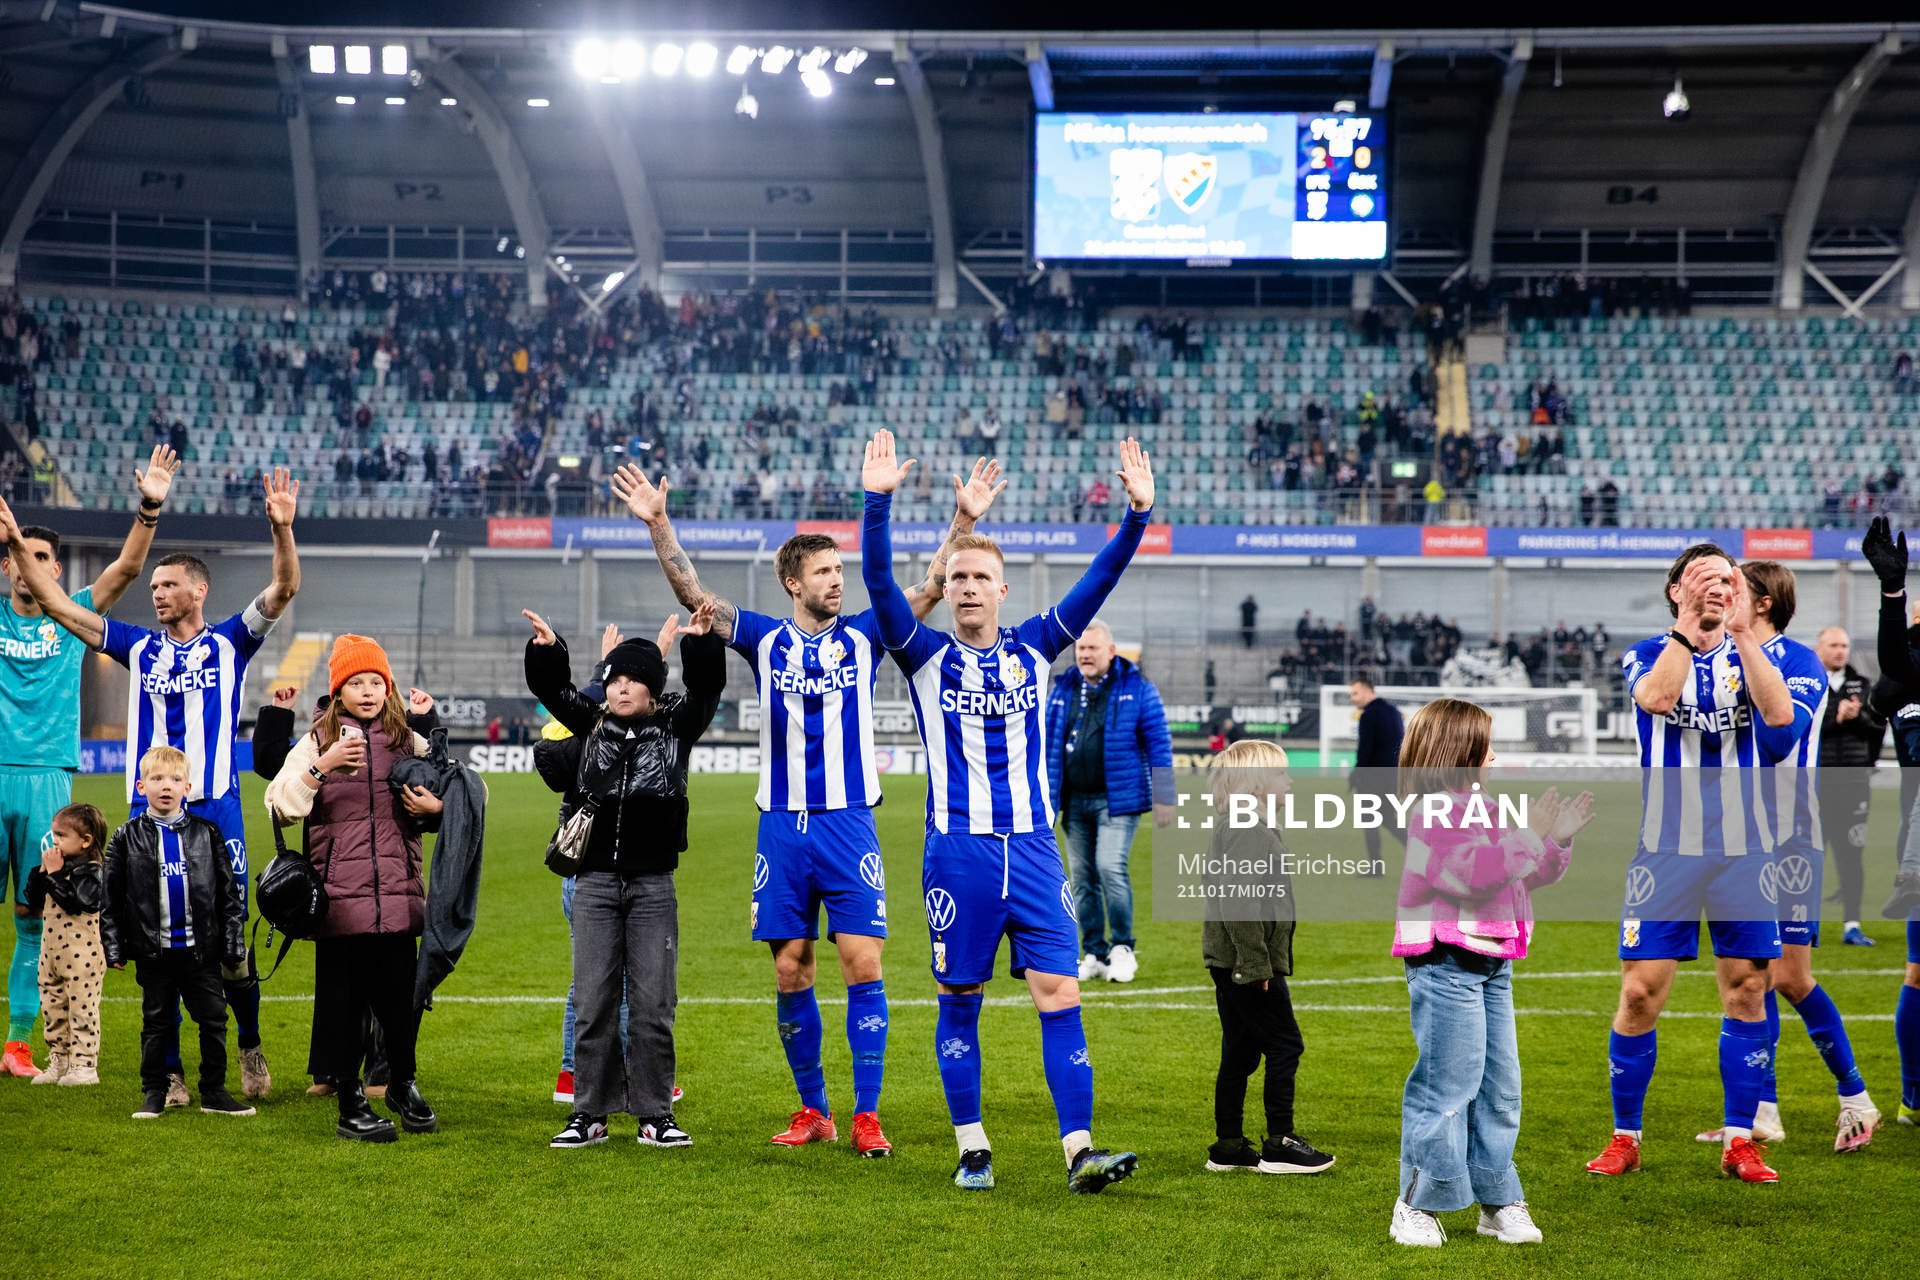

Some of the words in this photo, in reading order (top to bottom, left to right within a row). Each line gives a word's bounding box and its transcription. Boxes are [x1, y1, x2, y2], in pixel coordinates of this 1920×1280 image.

[1311, 146, 1327, 169] 2
[1035, 531, 1076, 546] PLATS
[142, 668, 217, 694] SERNEKE
[771, 665, 856, 695] SERNEKE
[941, 685, 1037, 715] SERNEKE
